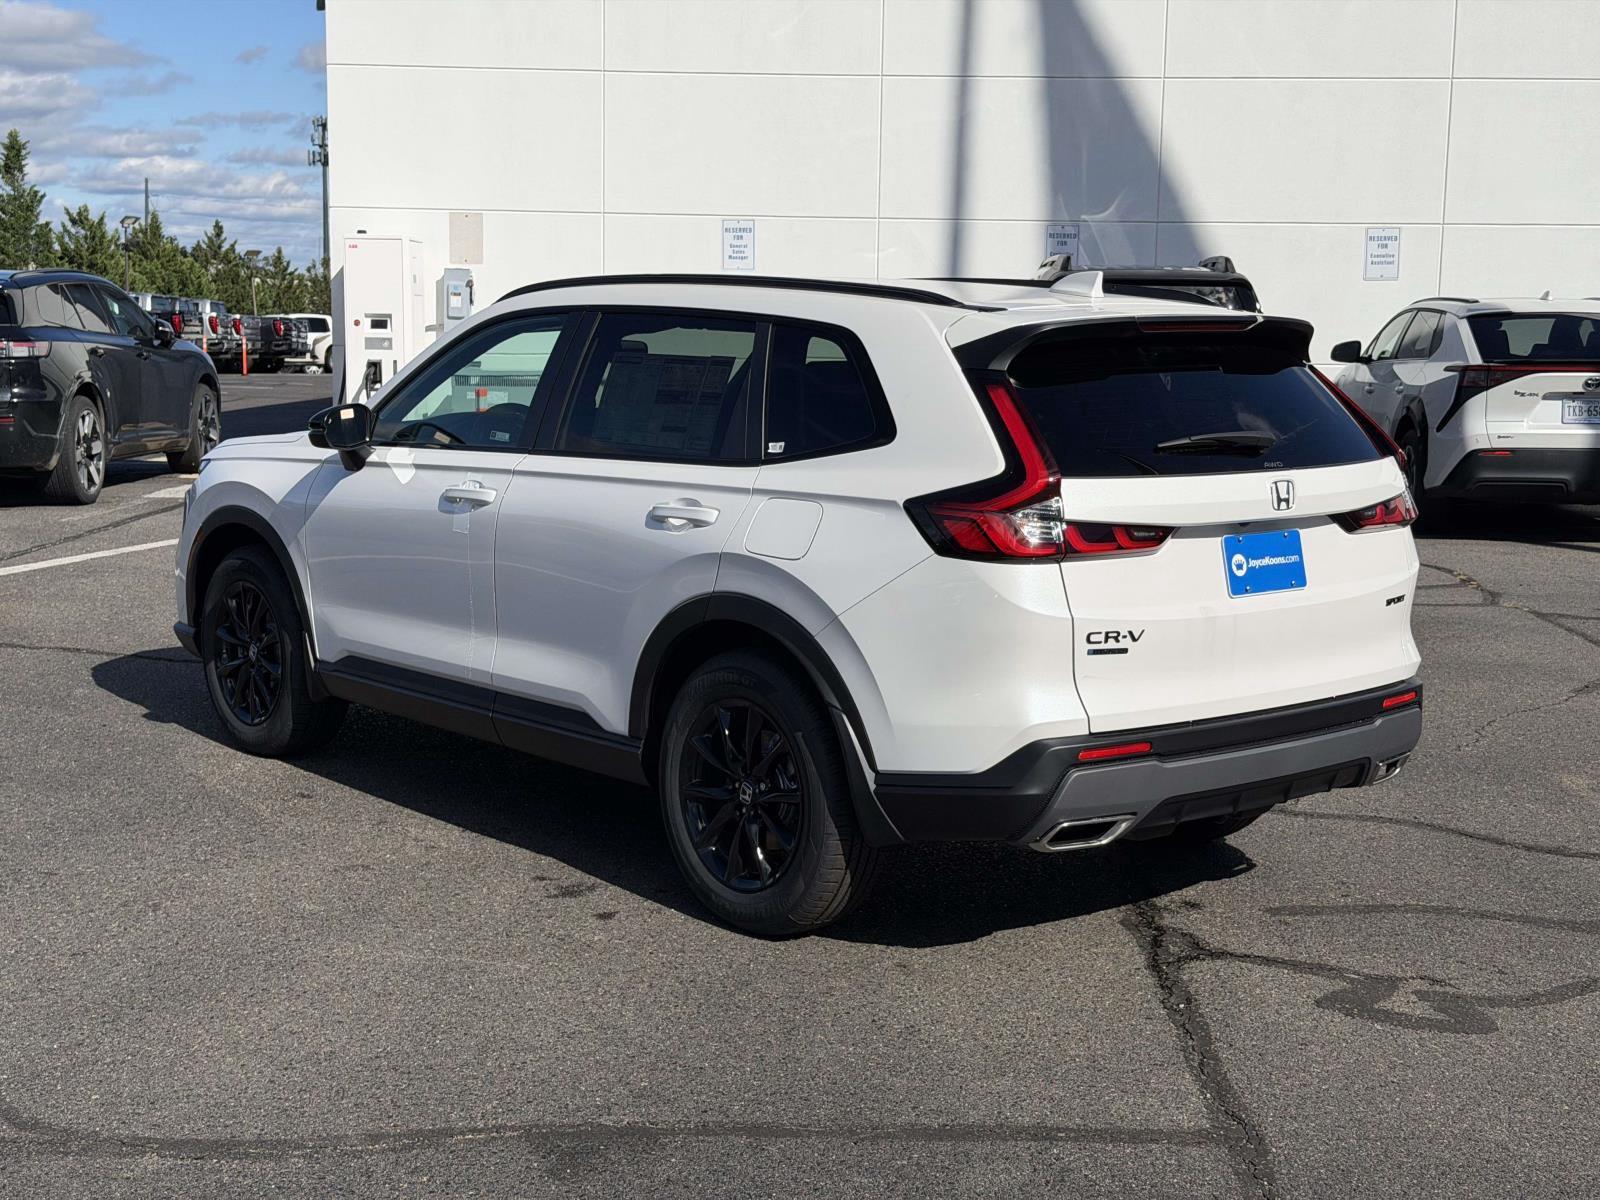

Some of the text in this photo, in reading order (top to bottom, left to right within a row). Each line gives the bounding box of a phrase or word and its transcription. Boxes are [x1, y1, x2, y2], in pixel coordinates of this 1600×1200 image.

[1377, 242, 1389, 250] FOR
[1566, 405, 1600, 417] TKB-65
[1247, 554, 1300, 569] JoyceKoons.com
[1085, 628, 1146, 645] CR-V
